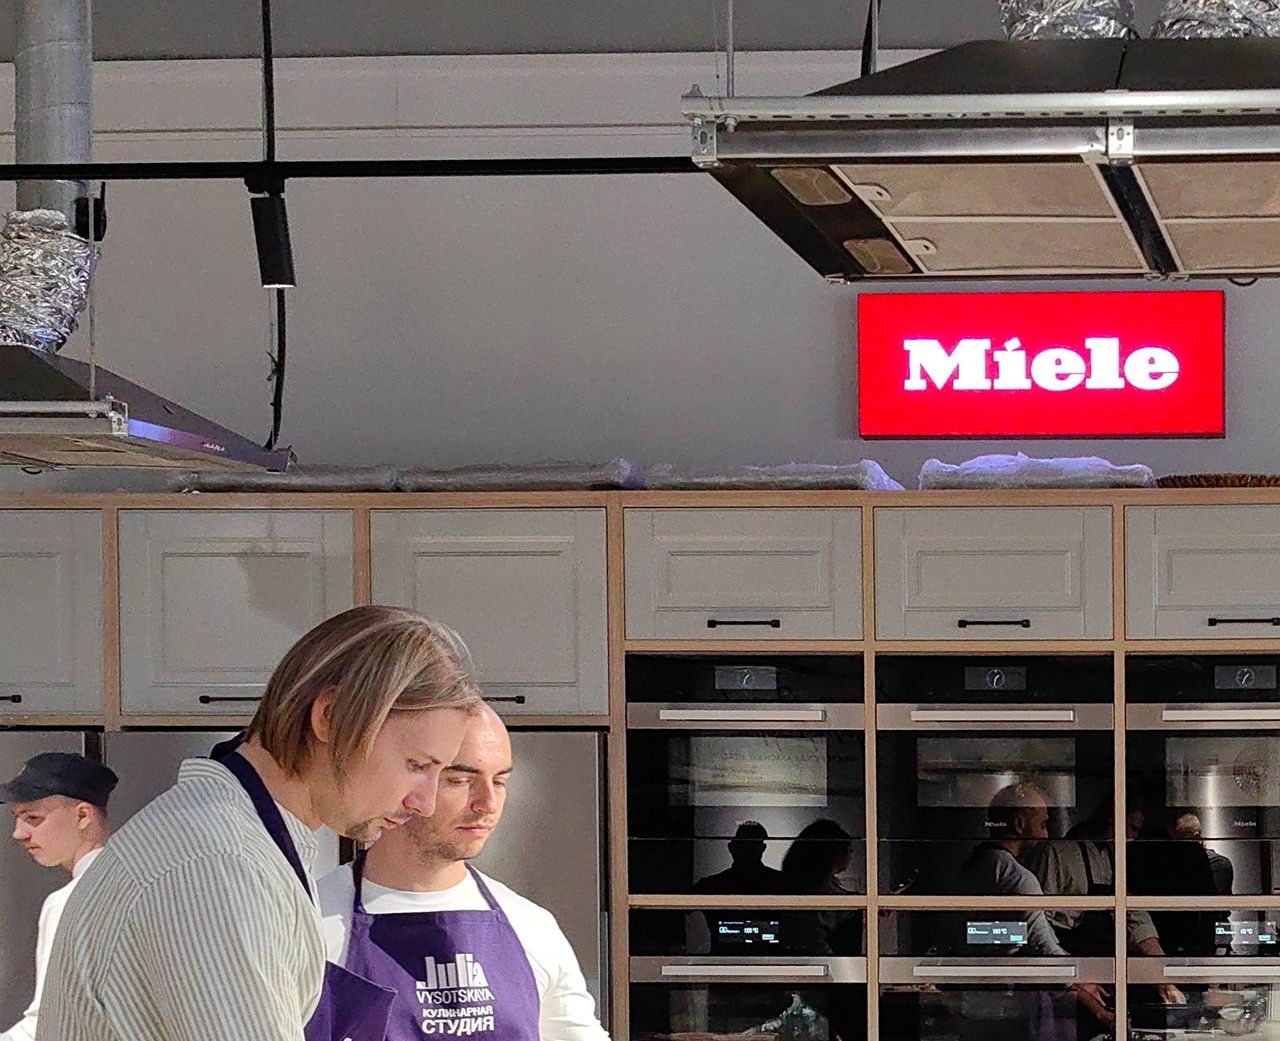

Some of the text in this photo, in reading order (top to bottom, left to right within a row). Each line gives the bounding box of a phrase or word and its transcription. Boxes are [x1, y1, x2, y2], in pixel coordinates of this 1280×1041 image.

[903, 336, 1180, 392] Miele
[416, 953, 489, 990] Julia
[416, 988, 496, 1004] VYSOTSKAYA
[422, 1004, 494, 1018] КУЛИНАРНАЯ
[421, 1015, 495, 1036] СТУДИЯ
